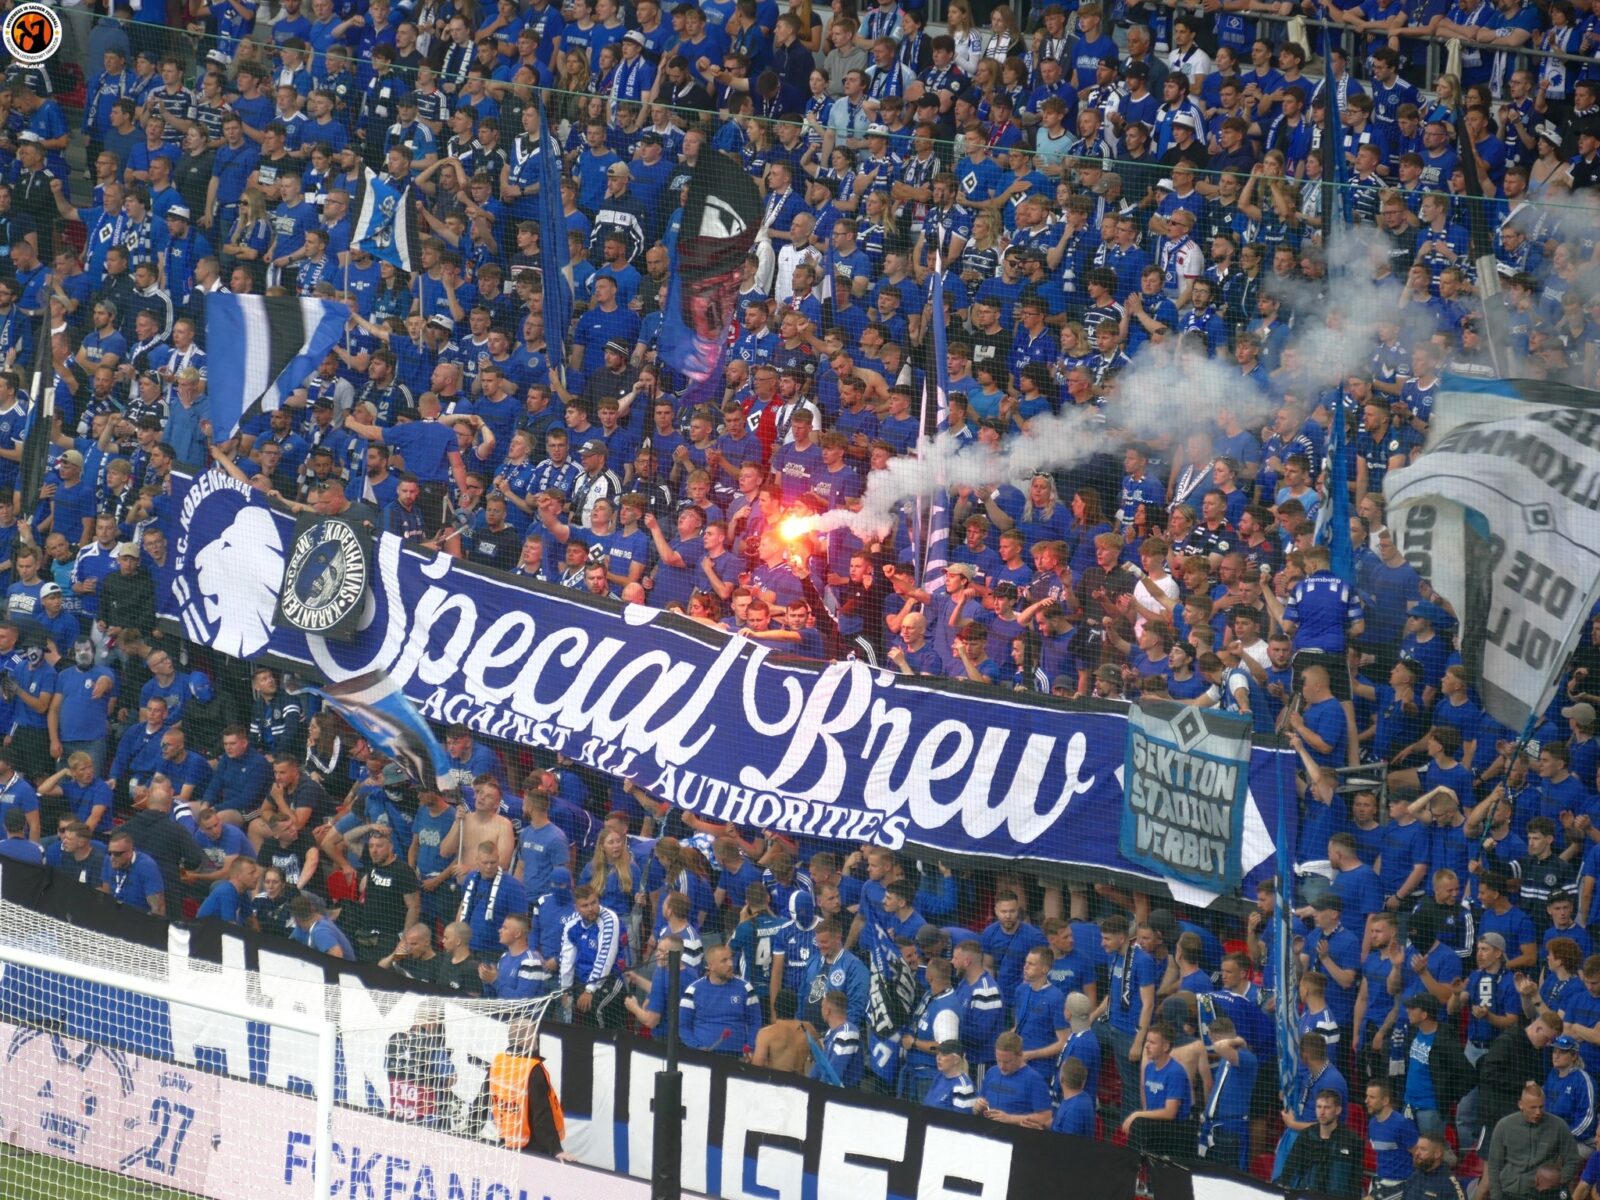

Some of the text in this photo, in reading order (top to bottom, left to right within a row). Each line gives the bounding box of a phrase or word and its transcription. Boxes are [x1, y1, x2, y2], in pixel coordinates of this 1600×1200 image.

[306, 531, 1096, 844] Special Brew
[419, 687, 912, 851] AGAINST ALL AUTHORITIES
[1132, 732, 1237, 801] SEKTION
[1131, 772, 1231, 840] STADION
[1136, 814, 1226, 875] VERBOT
